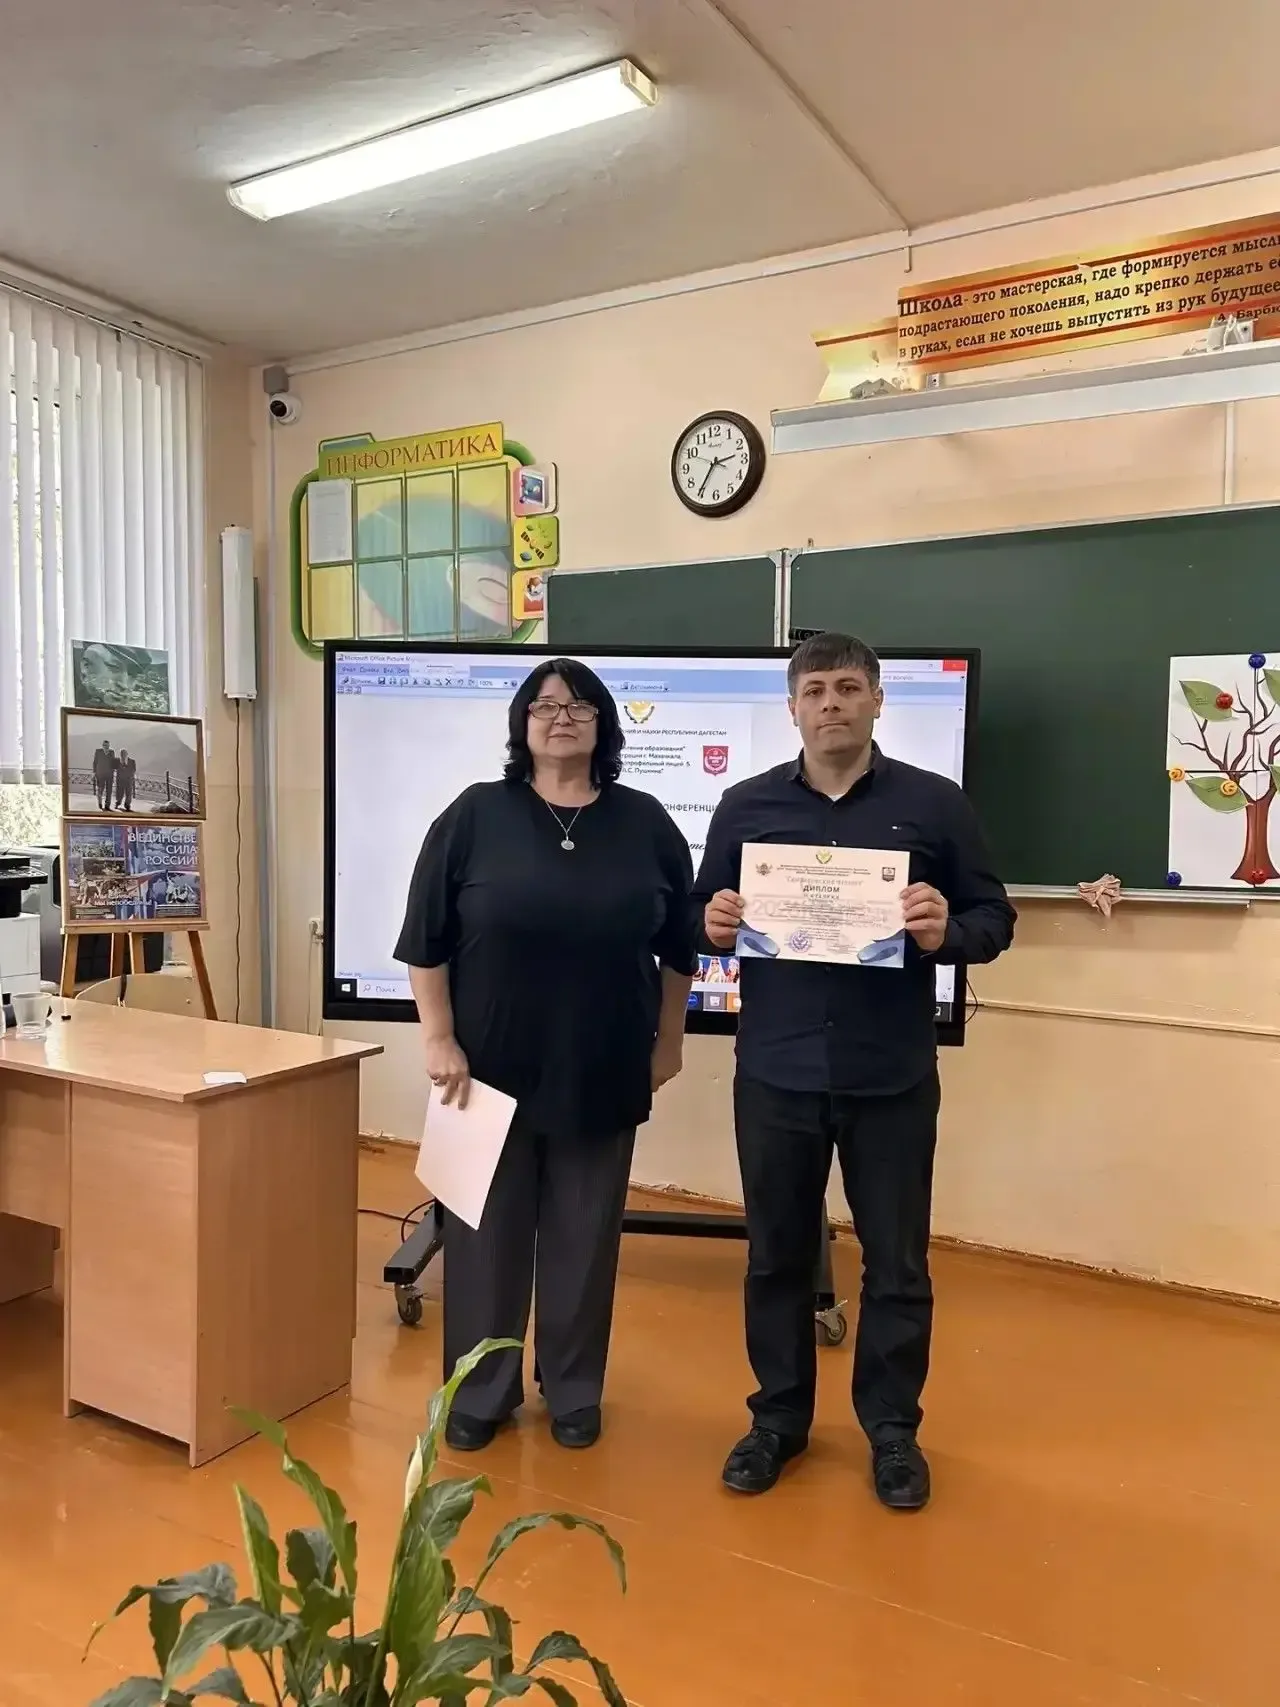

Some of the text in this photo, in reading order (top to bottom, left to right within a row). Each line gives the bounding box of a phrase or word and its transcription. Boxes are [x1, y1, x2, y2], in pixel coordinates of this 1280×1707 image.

[972, 290, 996, 304] это
[1000, 272, 1087, 299] мастерская,
[1092, 267, 1117, 282] где
[1121, 245, 1227, 278] формируется
[899, 309, 1005, 338] подрастающего
[1010, 294, 1090, 317] поколения,
[1095, 285, 1130, 302] надо
[1135, 275, 1190, 297] крепко
[1194, 261, 1263, 285] держать
[899, 347, 907, 358] в
[911, 340, 952, 359] руках,
[955, 334, 985, 348] если
[990, 330, 1006, 342] не
[1010, 322, 1063, 338] хочешь
[1068, 304, 1151, 328] выпустить
[1156, 300, 1173, 312] из
[1178, 294, 1206, 313] рук
[708, 425, 721, 438] 12
[727, 428, 732, 440] 1
[696, 432, 707, 446] 11
[736, 438, 744, 450] 2
[327, 432, 499, 476] ИНФОРМАТИКА
[687, 446, 699, 459] 10
[741, 452, 748, 464] 3
[682, 463, 690, 474] 9
[736, 469, 743, 481] 4
[687, 478, 695, 489] 8
[727, 483, 734, 494] 5
[712, 489, 720, 501] 6
[139, 831, 197, 844] ЕДИНСТВЕ
[166, 844, 197, 855] СИЛА
[145, 856, 198, 866] РОССИИ!
[803, 885, 840, 893] ДИПЛОМ
